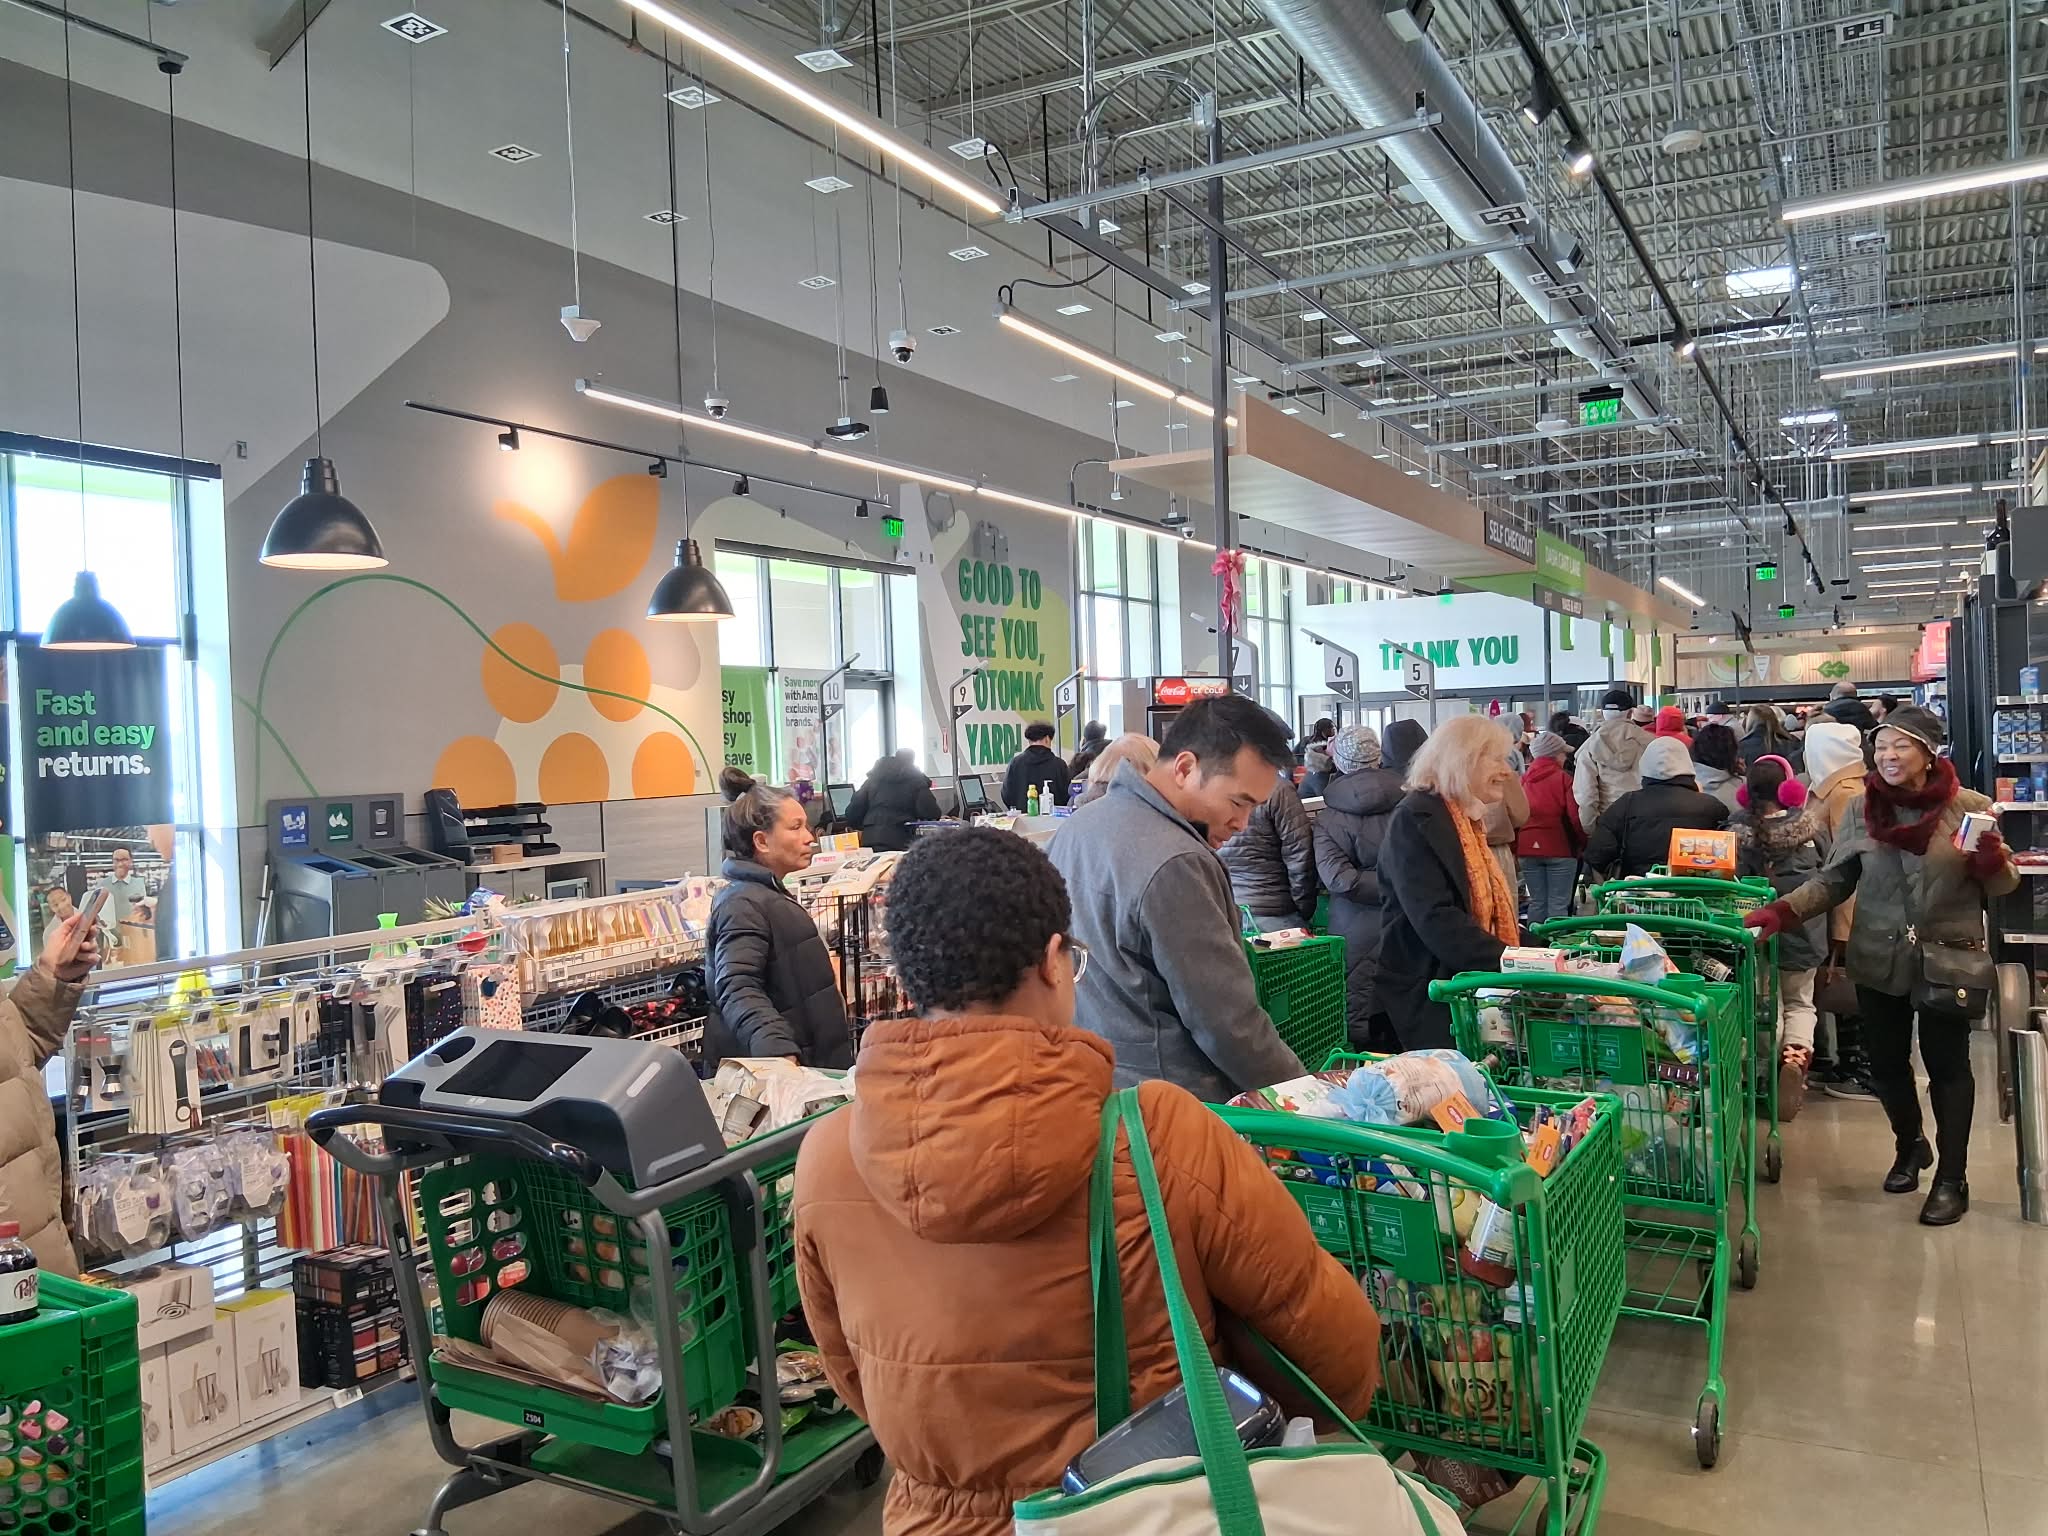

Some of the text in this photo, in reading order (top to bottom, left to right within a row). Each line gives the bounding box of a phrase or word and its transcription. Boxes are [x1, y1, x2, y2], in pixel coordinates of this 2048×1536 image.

[1489, 519, 1533, 558] SELF CHECKOUT
[959, 558, 1042, 611] GOOD TO
[960, 613, 1045, 667] SEE YOU,
[1467, 635, 1519, 666] YOU
[1334, 657, 1344, 678] 6
[1412, 663, 1421, 682] 5
[784, 676, 801, 688] Save
[826, 682, 840, 701] 10
[36, 689, 97, 716] Fast
[785, 689, 801, 701] with
[959, 687, 967, 703] 9
[1063, 687, 1070, 702] 8
[785, 704, 819, 714] exclusive
[785, 718, 813, 727] brands.
[37, 719, 156, 750] and easy
[965, 723, 1022, 766] YARD!
[38, 751, 151, 778] returns.
